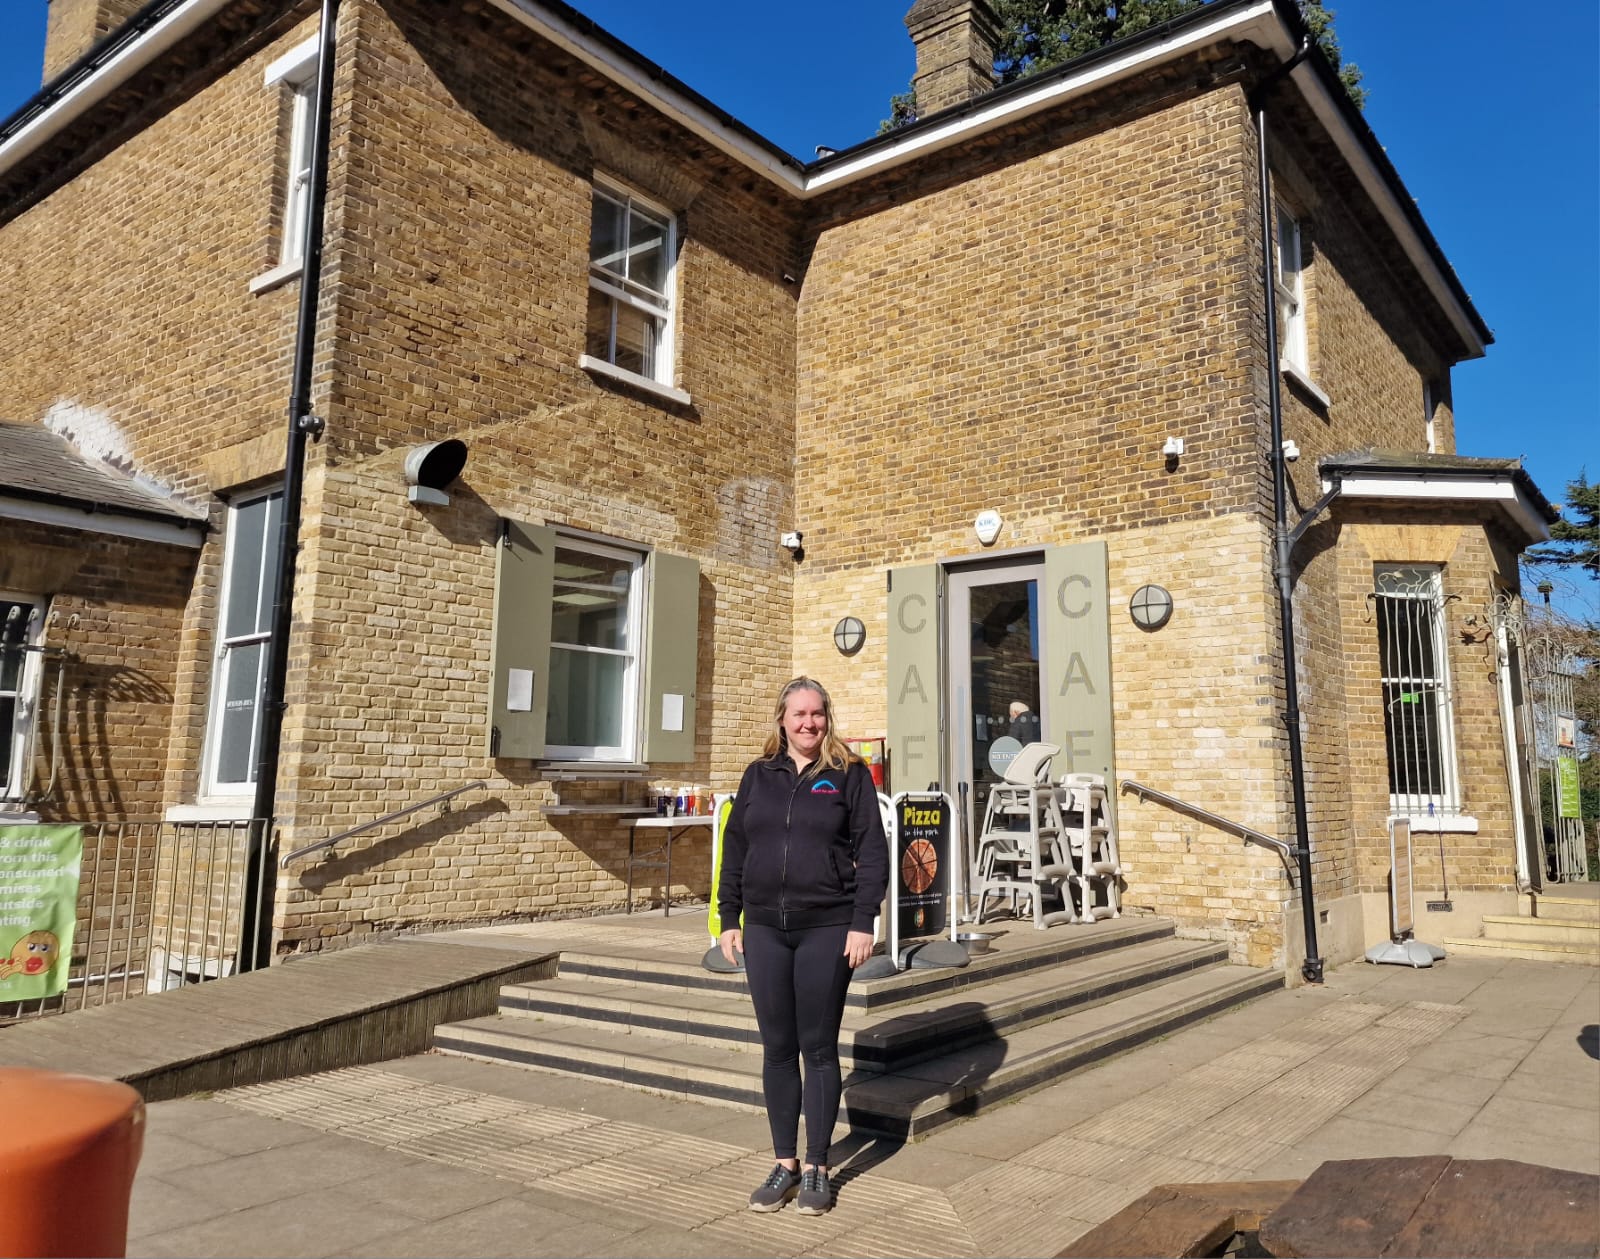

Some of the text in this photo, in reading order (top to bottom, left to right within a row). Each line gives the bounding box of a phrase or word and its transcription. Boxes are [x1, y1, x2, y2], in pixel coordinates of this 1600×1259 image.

[904, 806, 940, 826] Pizza
[913, 827, 923, 837] the
[925, 828, 939, 839] park
[15, 836, 51, 848] drink
[0, 852, 57, 864] rom this
[0, 867, 64, 878] onsumed
[0, 885, 41, 895] mises
[0, 899, 43, 910] utside
